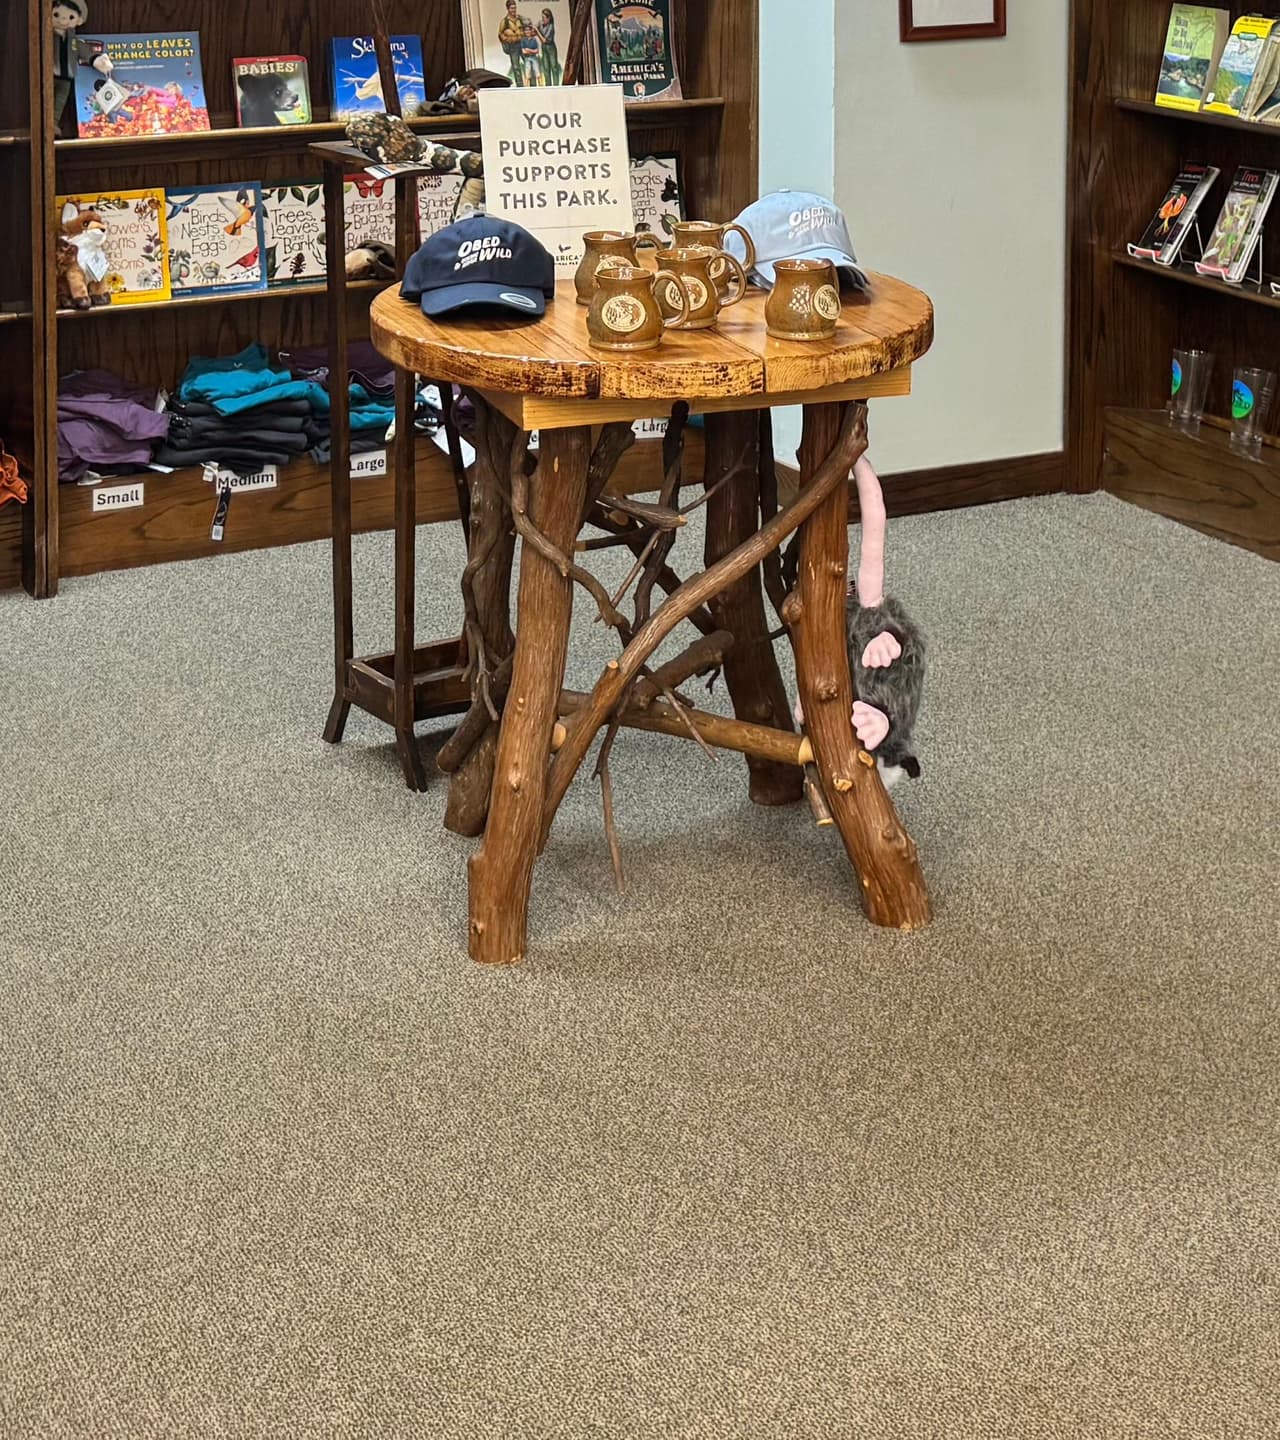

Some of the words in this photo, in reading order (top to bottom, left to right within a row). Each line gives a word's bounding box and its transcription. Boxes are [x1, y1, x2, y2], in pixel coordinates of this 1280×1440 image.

[130, 42, 144, 50] DO
[146, 38, 192, 49] LEAVES
[109, 49, 152, 60] CHANGE
[155, 48, 194, 58] COLOR?
[238, 62, 299, 76] BABIES!
[610, 63, 665, 74] AMERICA'S
[643, 72, 665, 80] PARKS
[523, 112, 582, 130] YOUR
[499, 137, 611, 157] PURCHASE
[502, 163, 611, 183] SUPPORTS
[500, 192, 547, 209] THIS
[556, 189, 618, 207] PARK.
[789, 207, 824, 226] OBED
[181, 223, 220, 240] Nests
[271, 221, 319, 238] Leaves
[192, 239, 227, 256] Eggs
[283, 235, 316, 252] Bark
[458, 236, 500, 257] OBED
[480, 248, 512, 261] WILD
[96, 488, 140, 506] Small
